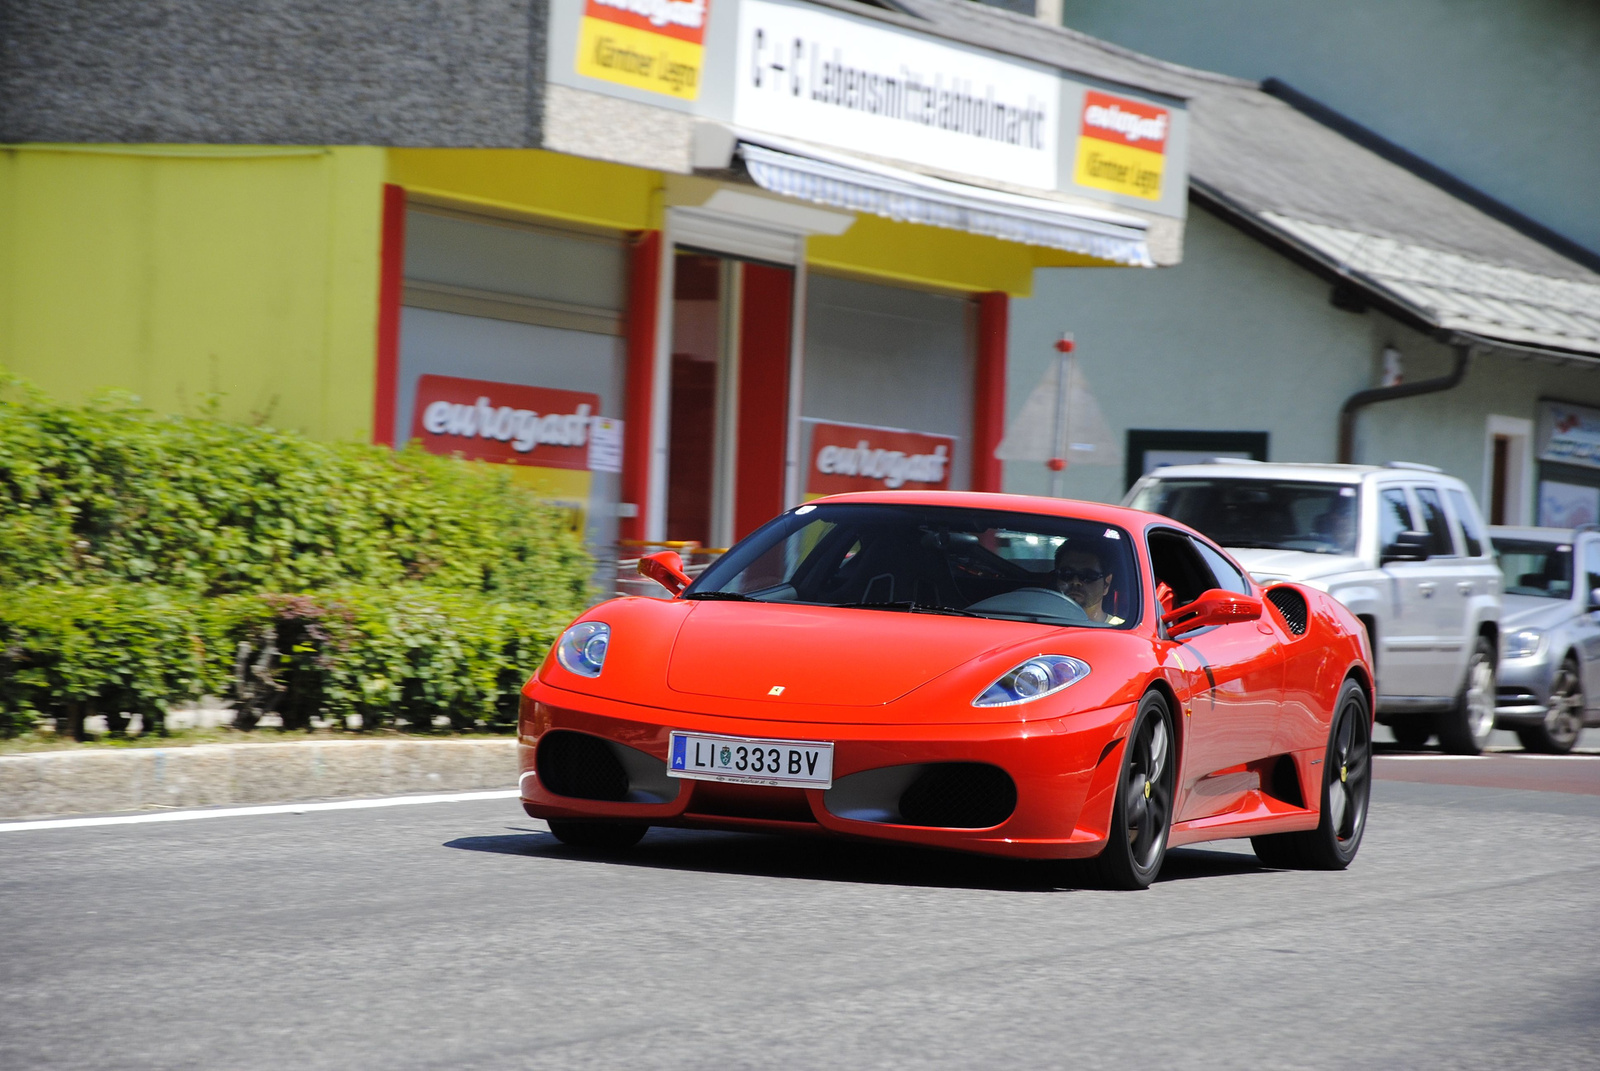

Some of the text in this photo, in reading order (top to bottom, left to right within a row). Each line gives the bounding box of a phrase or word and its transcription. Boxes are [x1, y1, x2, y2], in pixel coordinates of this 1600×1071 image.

[754, 27, 765, 88] C
[792, 37, 804, 97] C
[810, 42, 1047, 150] Lebensmittelabholmarkt
[1084, 104, 1168, 141] eurogast
[422, 396, 592, 454] eurogast
[816, 439, 948, 489] eurogast
[675, 756, 683, 765] A
[695, 742, 819, 776] LI 333 BV
